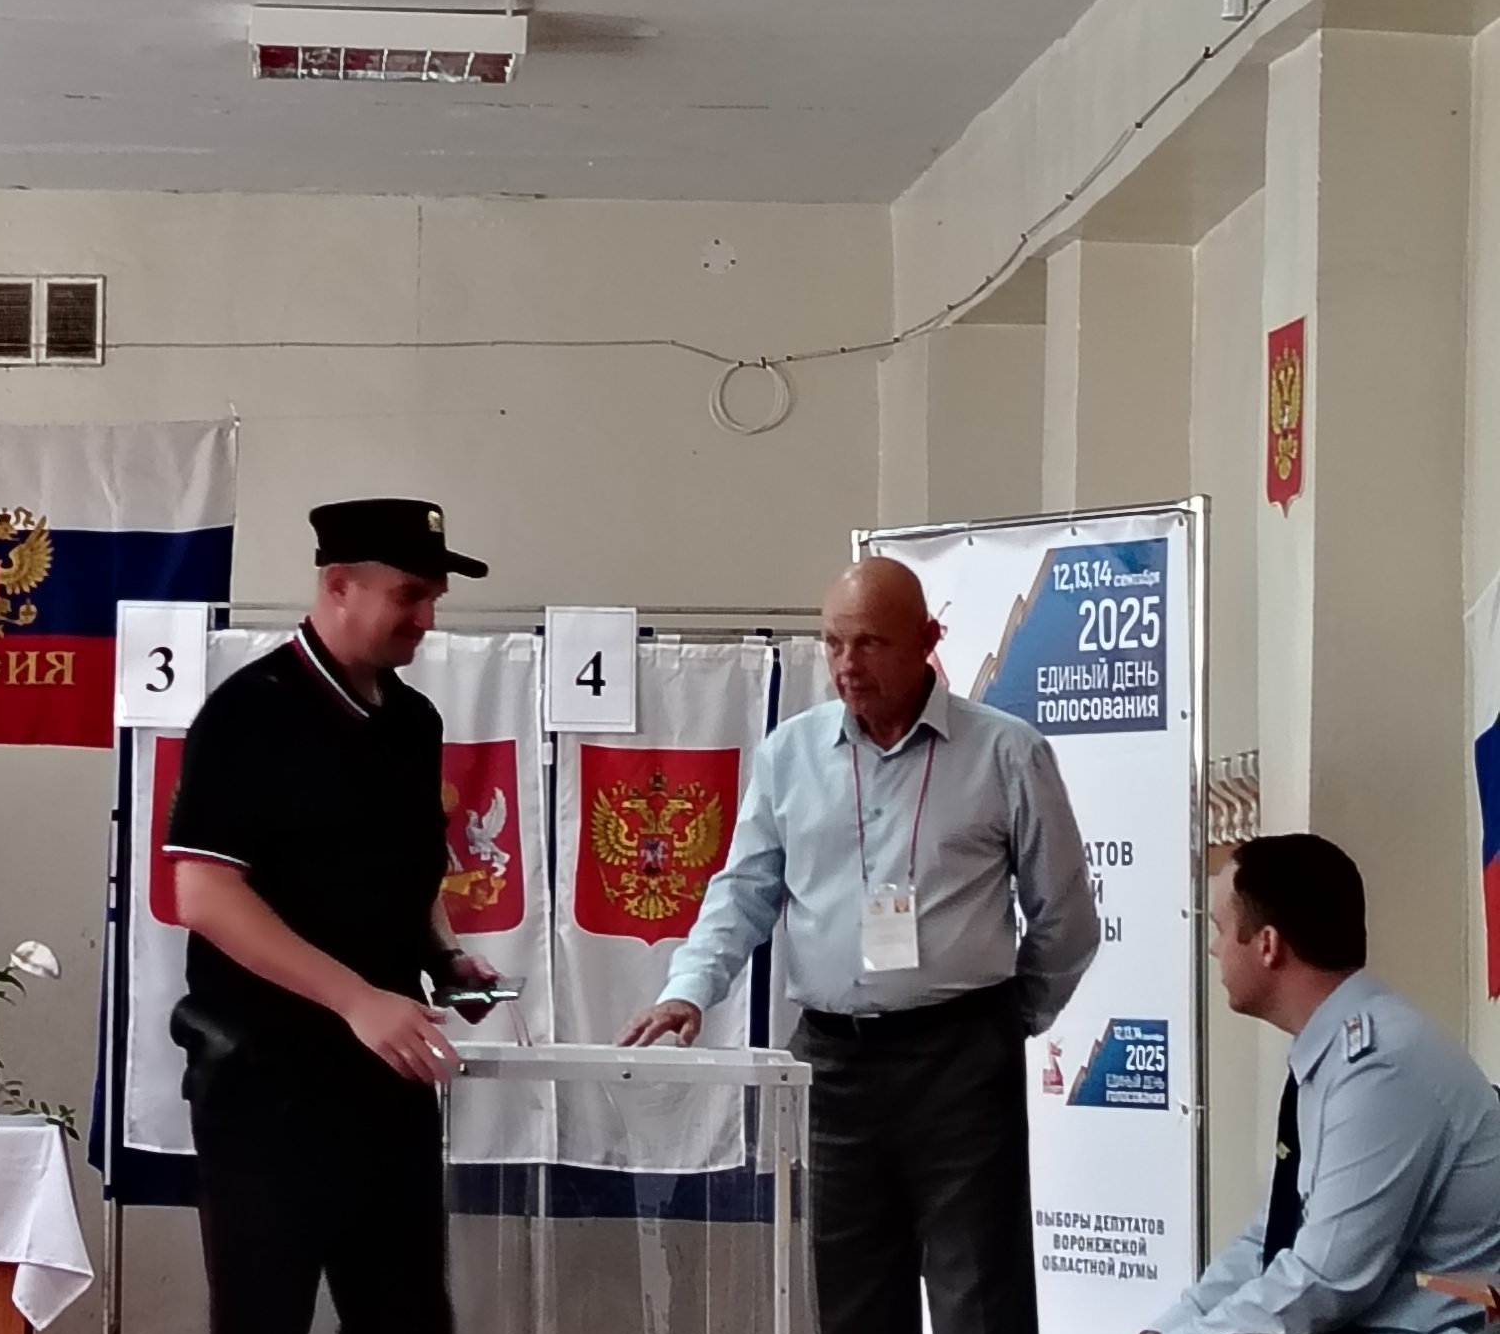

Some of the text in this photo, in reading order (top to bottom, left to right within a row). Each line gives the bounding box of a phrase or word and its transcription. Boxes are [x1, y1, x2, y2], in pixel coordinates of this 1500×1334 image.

[1053, 559, 1112, 593] 12,13,14
[1078, 595, 1160, 652] 2025
[145, 646, 176, 693] 3
[574, 650, 606, 698] 4
[1037, 658, 1160, 695] ЕДИНЫЙ ДЕНЬ
[1125, 1044, 1166, 1072] 2025
[1036, 1210, 1165, 1235] ВЫБОРЫ ДЕПУТАТОВ
[1053, 1233, 1147, 1257] ВОРОНЕЖСКОЙ
[1042, 1254, 1158, 1280] ОБЛАСТНОЙ ДУМЫ
